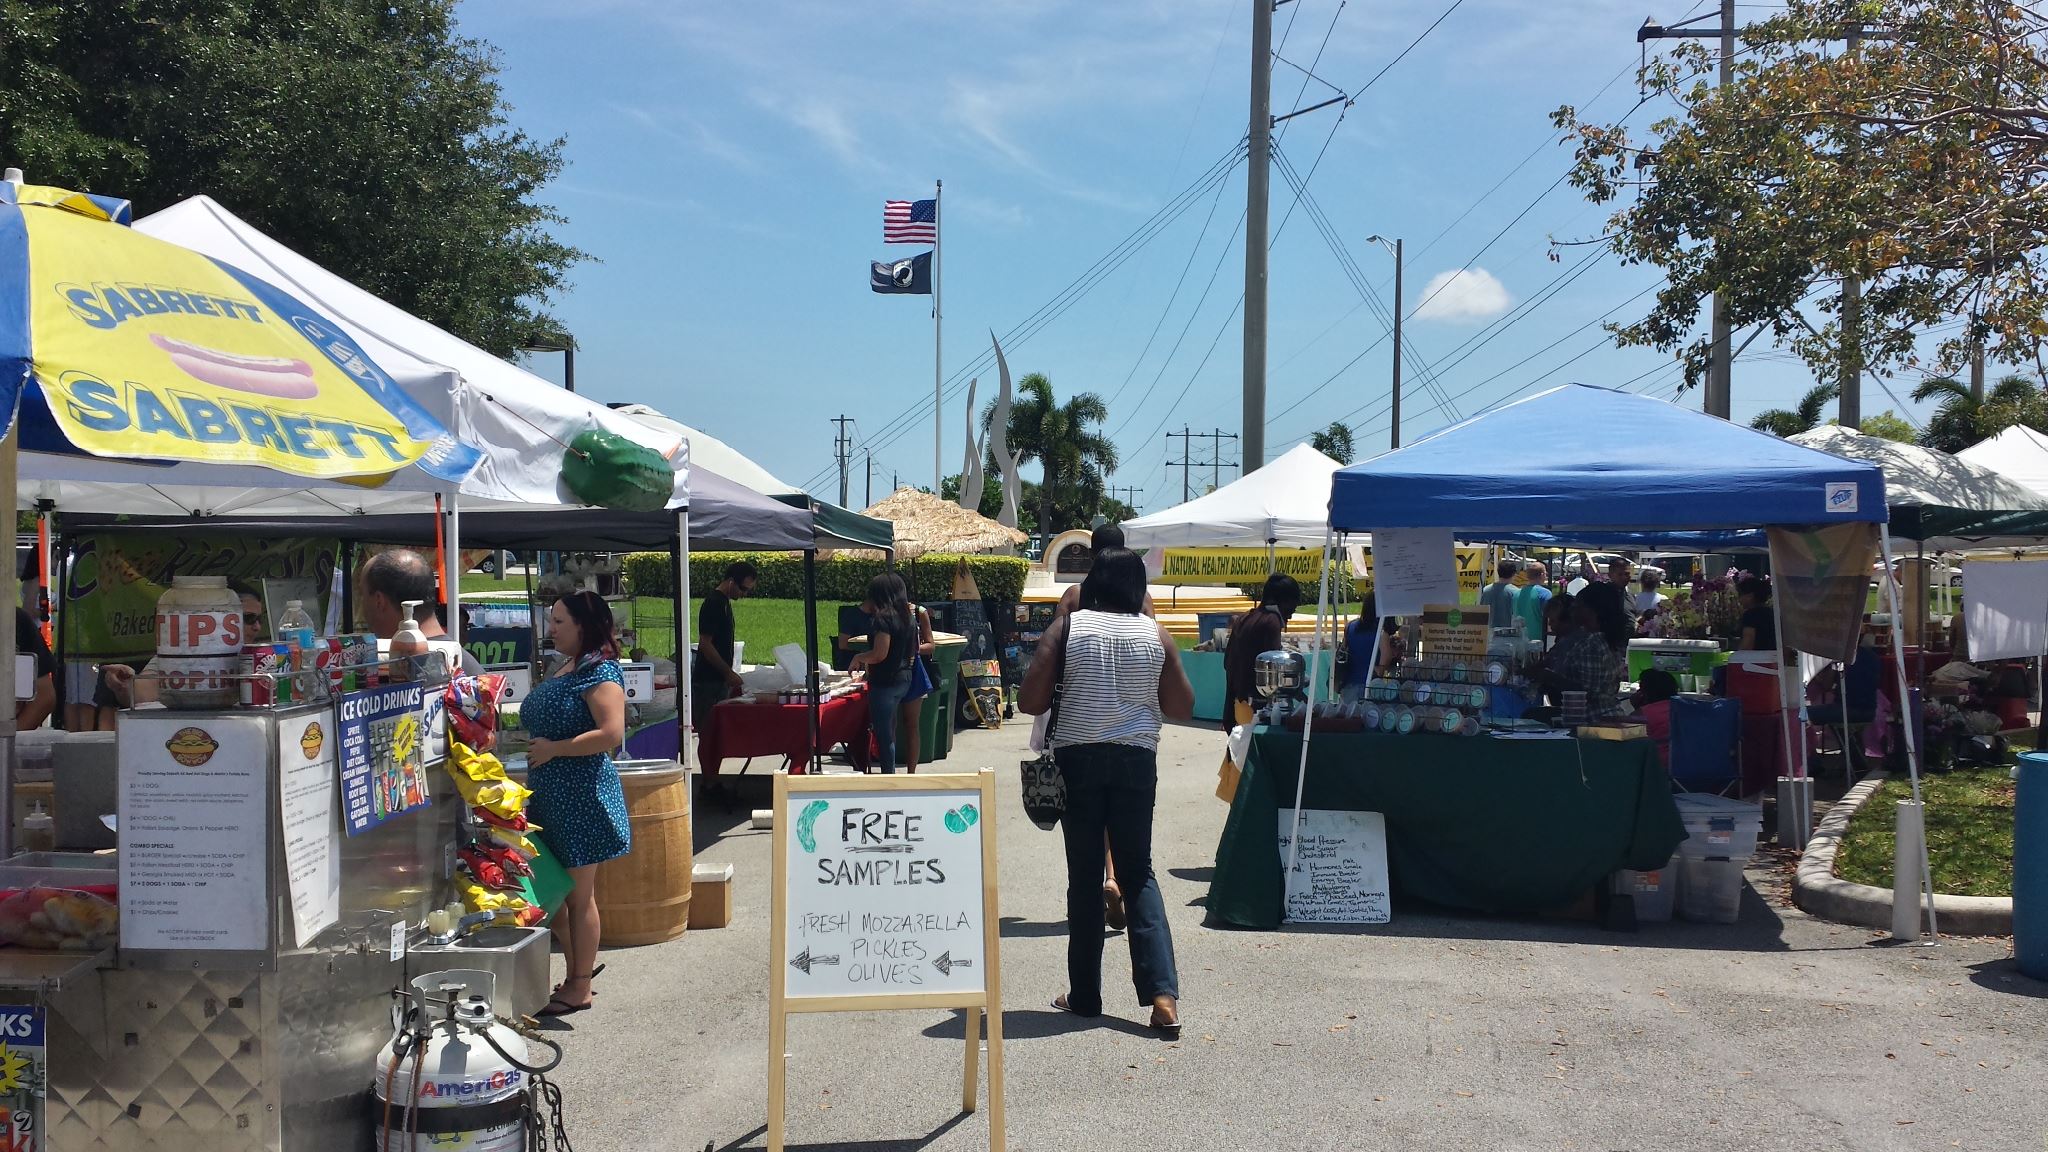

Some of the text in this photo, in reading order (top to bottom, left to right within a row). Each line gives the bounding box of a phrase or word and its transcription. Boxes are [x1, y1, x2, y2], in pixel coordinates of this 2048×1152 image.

[56, 278, 264, 330] SABRETT
[59, 370, 412, 462] SABRETT
[1170, 556, 1200, 575] NATURAL
[1202, 556, 1229, 575] HEALTHY
[1231, 556, 1259, 575] BISCUITS
[1275, 556, 1292, 574] YOUR
[1292, 556, 1311, 574] DOGS
[156, 613, 241, 647] TIPS
[340, 687, 421, 722] ICE COLD DRINKS
[343, 737, 355, 748] COCA
[841, 807, 924, 844] FREE
[1297, 835, 1346, 845] Blood Pressure
[1298, 844, 1315, 852] Blood
[817, 858, 946, 886] SAMPLES
[798, 911, 850, 937] FRESH
[862, 911, 971, 934] MOZZARELLA
[851, 938, 927, 960] PICKLES
[848, 963, 923, 985] OLIVES
[420, 1069, 521, 1097] AmeriGas
